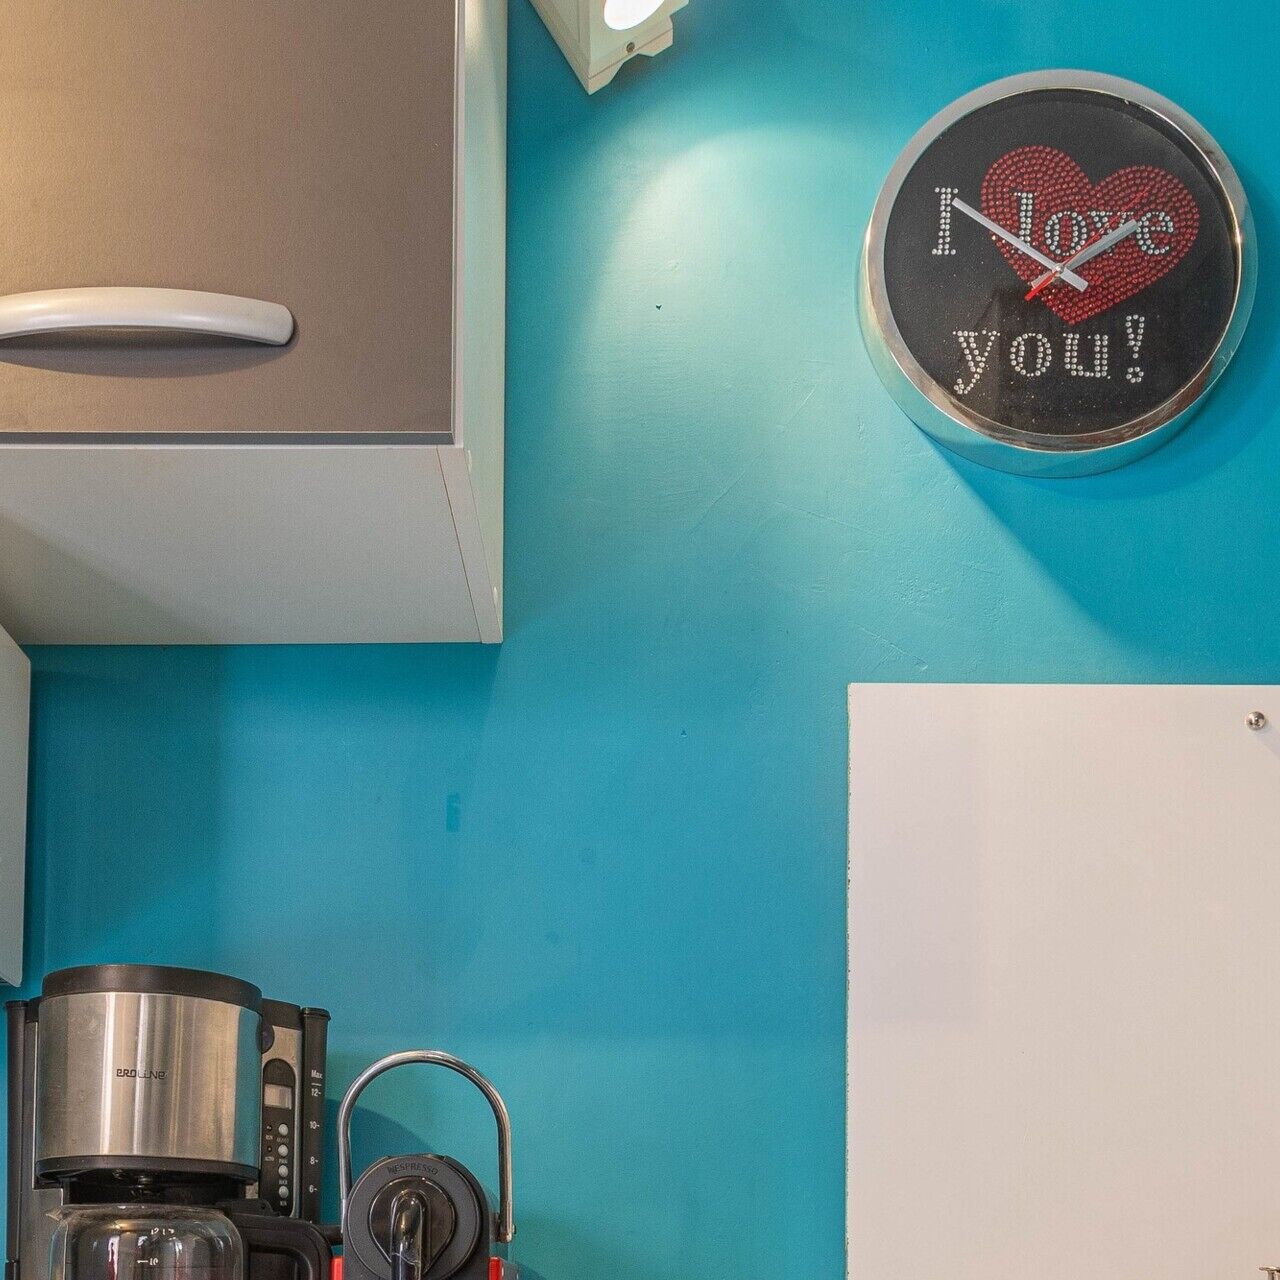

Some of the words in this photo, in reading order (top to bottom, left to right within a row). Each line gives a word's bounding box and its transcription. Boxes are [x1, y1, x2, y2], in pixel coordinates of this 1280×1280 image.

[931, 187, 960, 256] I
[952, 314, 1147, 395] you!
[387, 1161, 438, 1175] NESPRESSO
